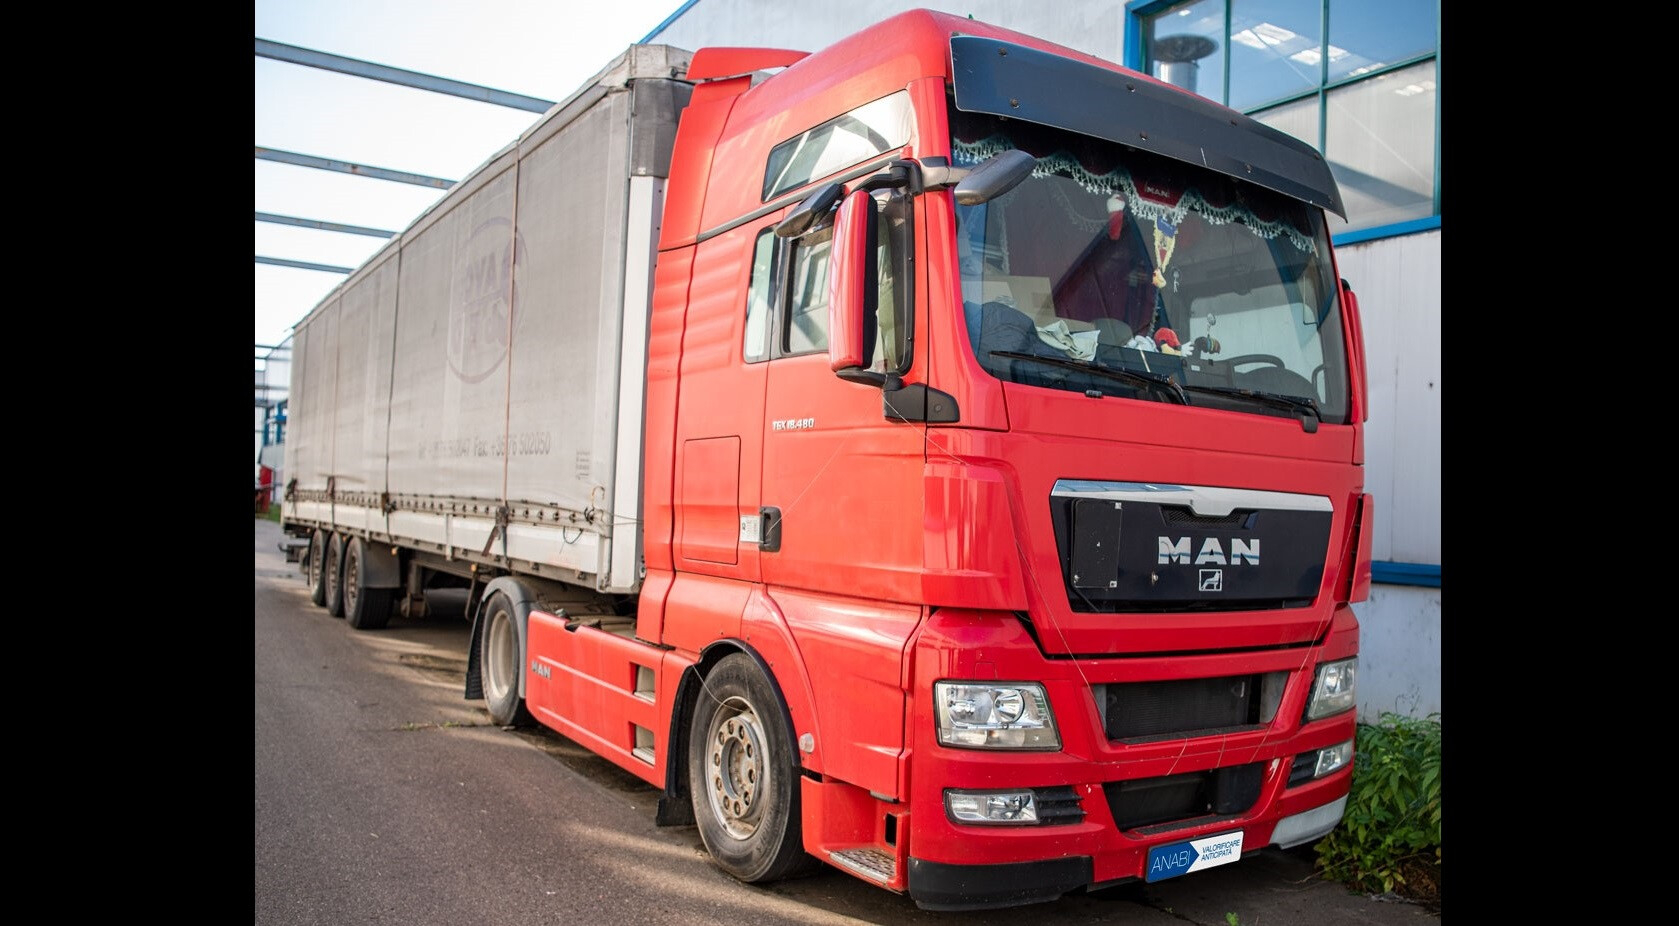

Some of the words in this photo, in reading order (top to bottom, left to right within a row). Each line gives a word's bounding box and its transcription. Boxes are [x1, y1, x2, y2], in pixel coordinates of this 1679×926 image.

[1146, 187, 1168, 197] MAN
[787, 418, 814, 430] 18.480
[519, 431, 552, 456] 502050
[1158, 536, 1260, 565] MAN
[532, 660, 550, 679] MAN
[1202, 839, 1240, 853] VALORIFICARE
[1150, 850, 1191, 874] ANABI
